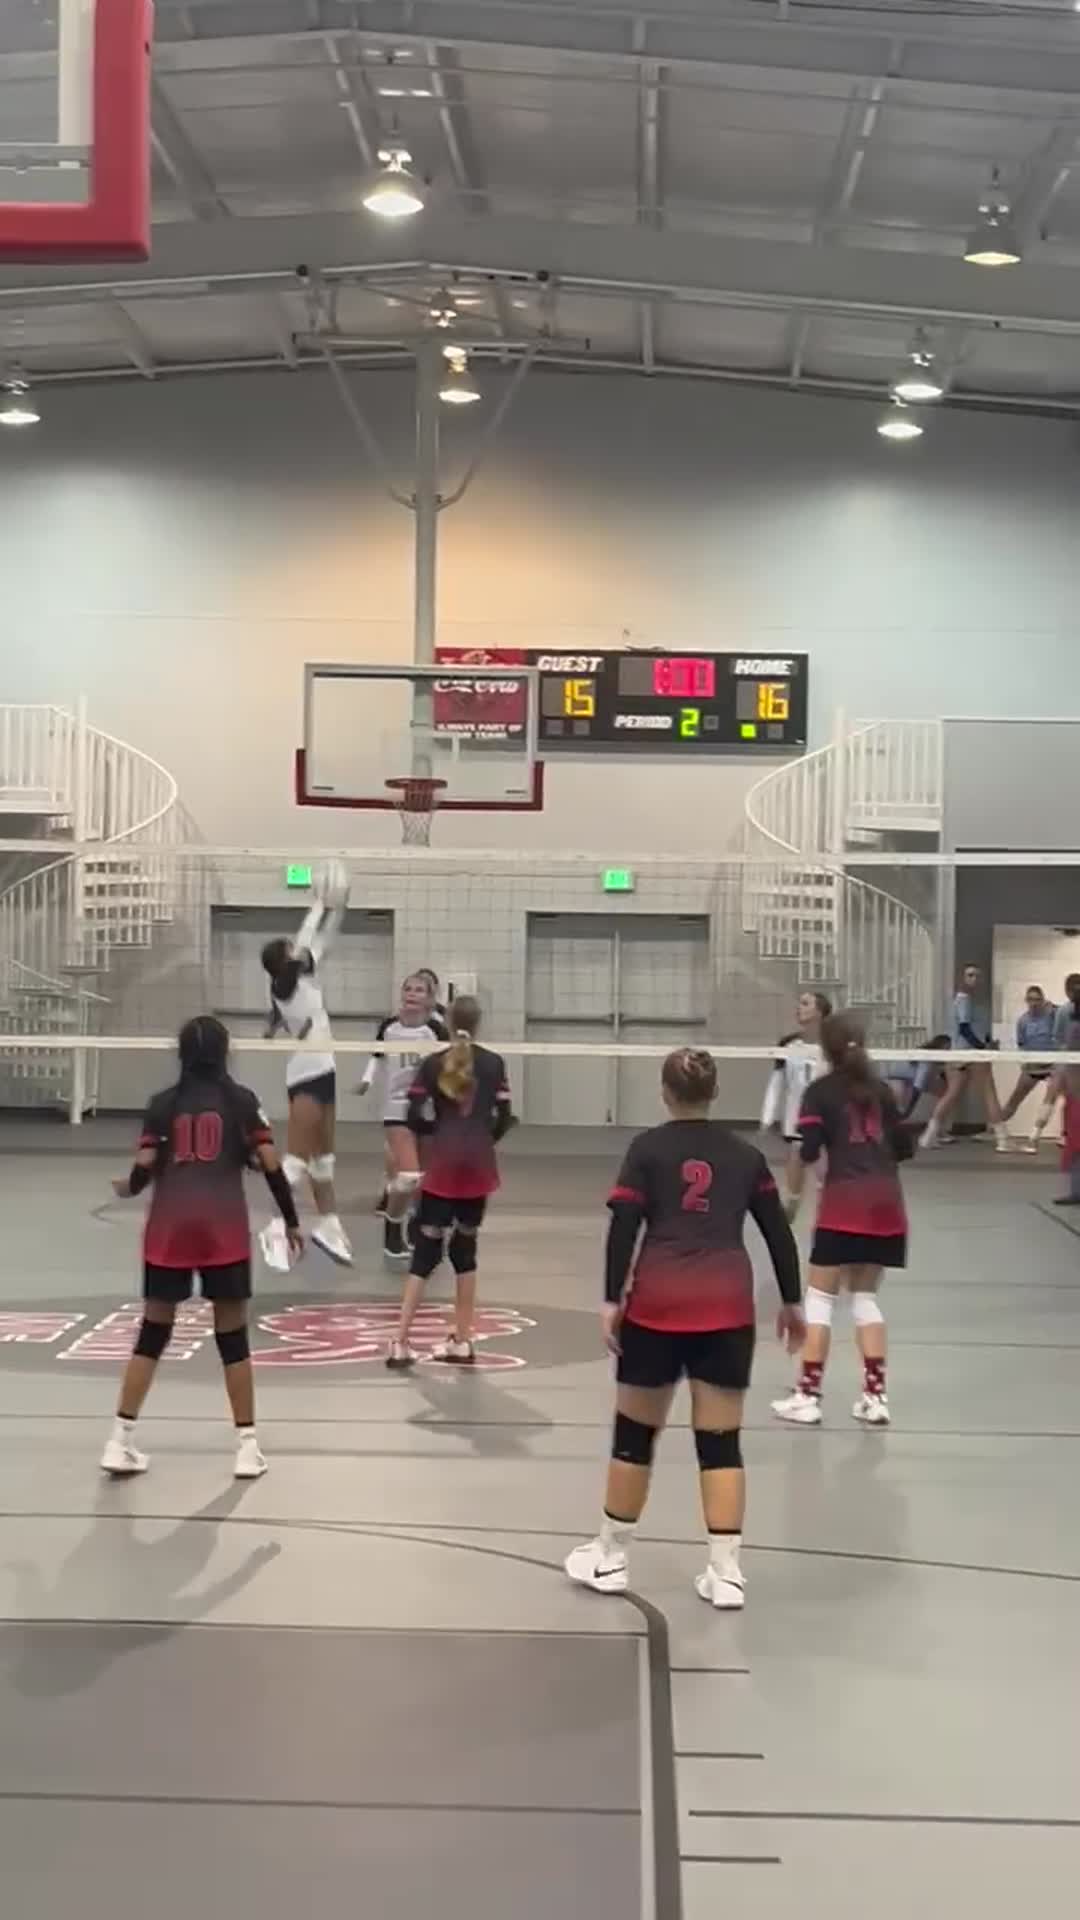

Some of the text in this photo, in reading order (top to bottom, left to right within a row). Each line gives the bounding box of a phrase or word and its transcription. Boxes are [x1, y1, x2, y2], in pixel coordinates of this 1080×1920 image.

[537, 656, 604, 673] GUEST
[734, 659, 794, 676] HOME
[564, 678, 595, 717] 15
[757, 684, 789, 719] 16
[679, 707, 700, 737] 2
[174, 1111, 223, 1162] 10
[681, 1158, 712, 1213] 2
